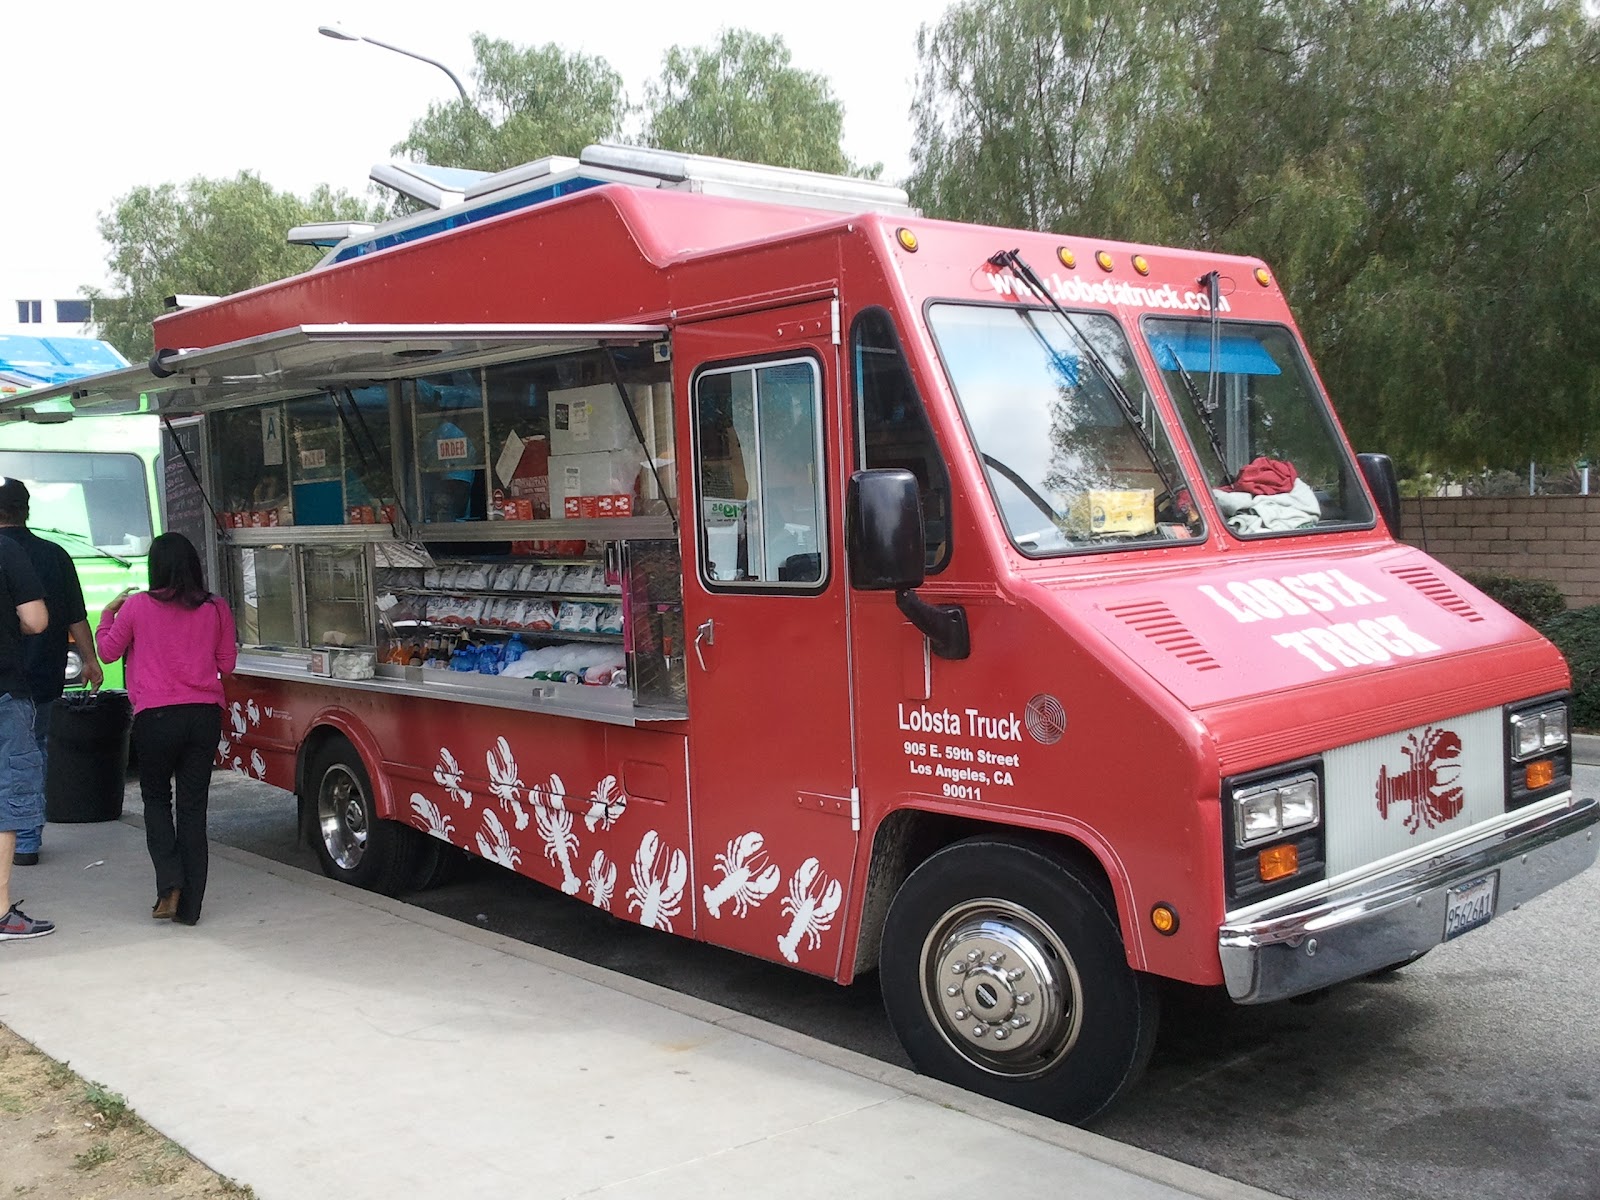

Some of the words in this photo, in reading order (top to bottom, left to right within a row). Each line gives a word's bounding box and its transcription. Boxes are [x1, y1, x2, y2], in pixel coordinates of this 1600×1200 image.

[267, 416, 277, 441] A
[440, 441, 465, 457] ORDER
[1197, 569, 1388, 623] LOBSTA
[1271, 615, 1442, 672] TRUCK
[898, 703, 961, 735] Lobsta
[965, 708, 1022, 741] Truck
[904, 741, 927, 756] 905
[930, 745, 942, 758] E.
[945, 746, 974, 762] 59th
[977, 750, 1019, 767] Street
[910, 760, 932, 775] Los
[935, 763, 990, 786] Angeles,
[993, 771, 1014, 786] CA
[942, 783, 981, 800] 90011
[1448, 893, 1490, 934] 95626A1
